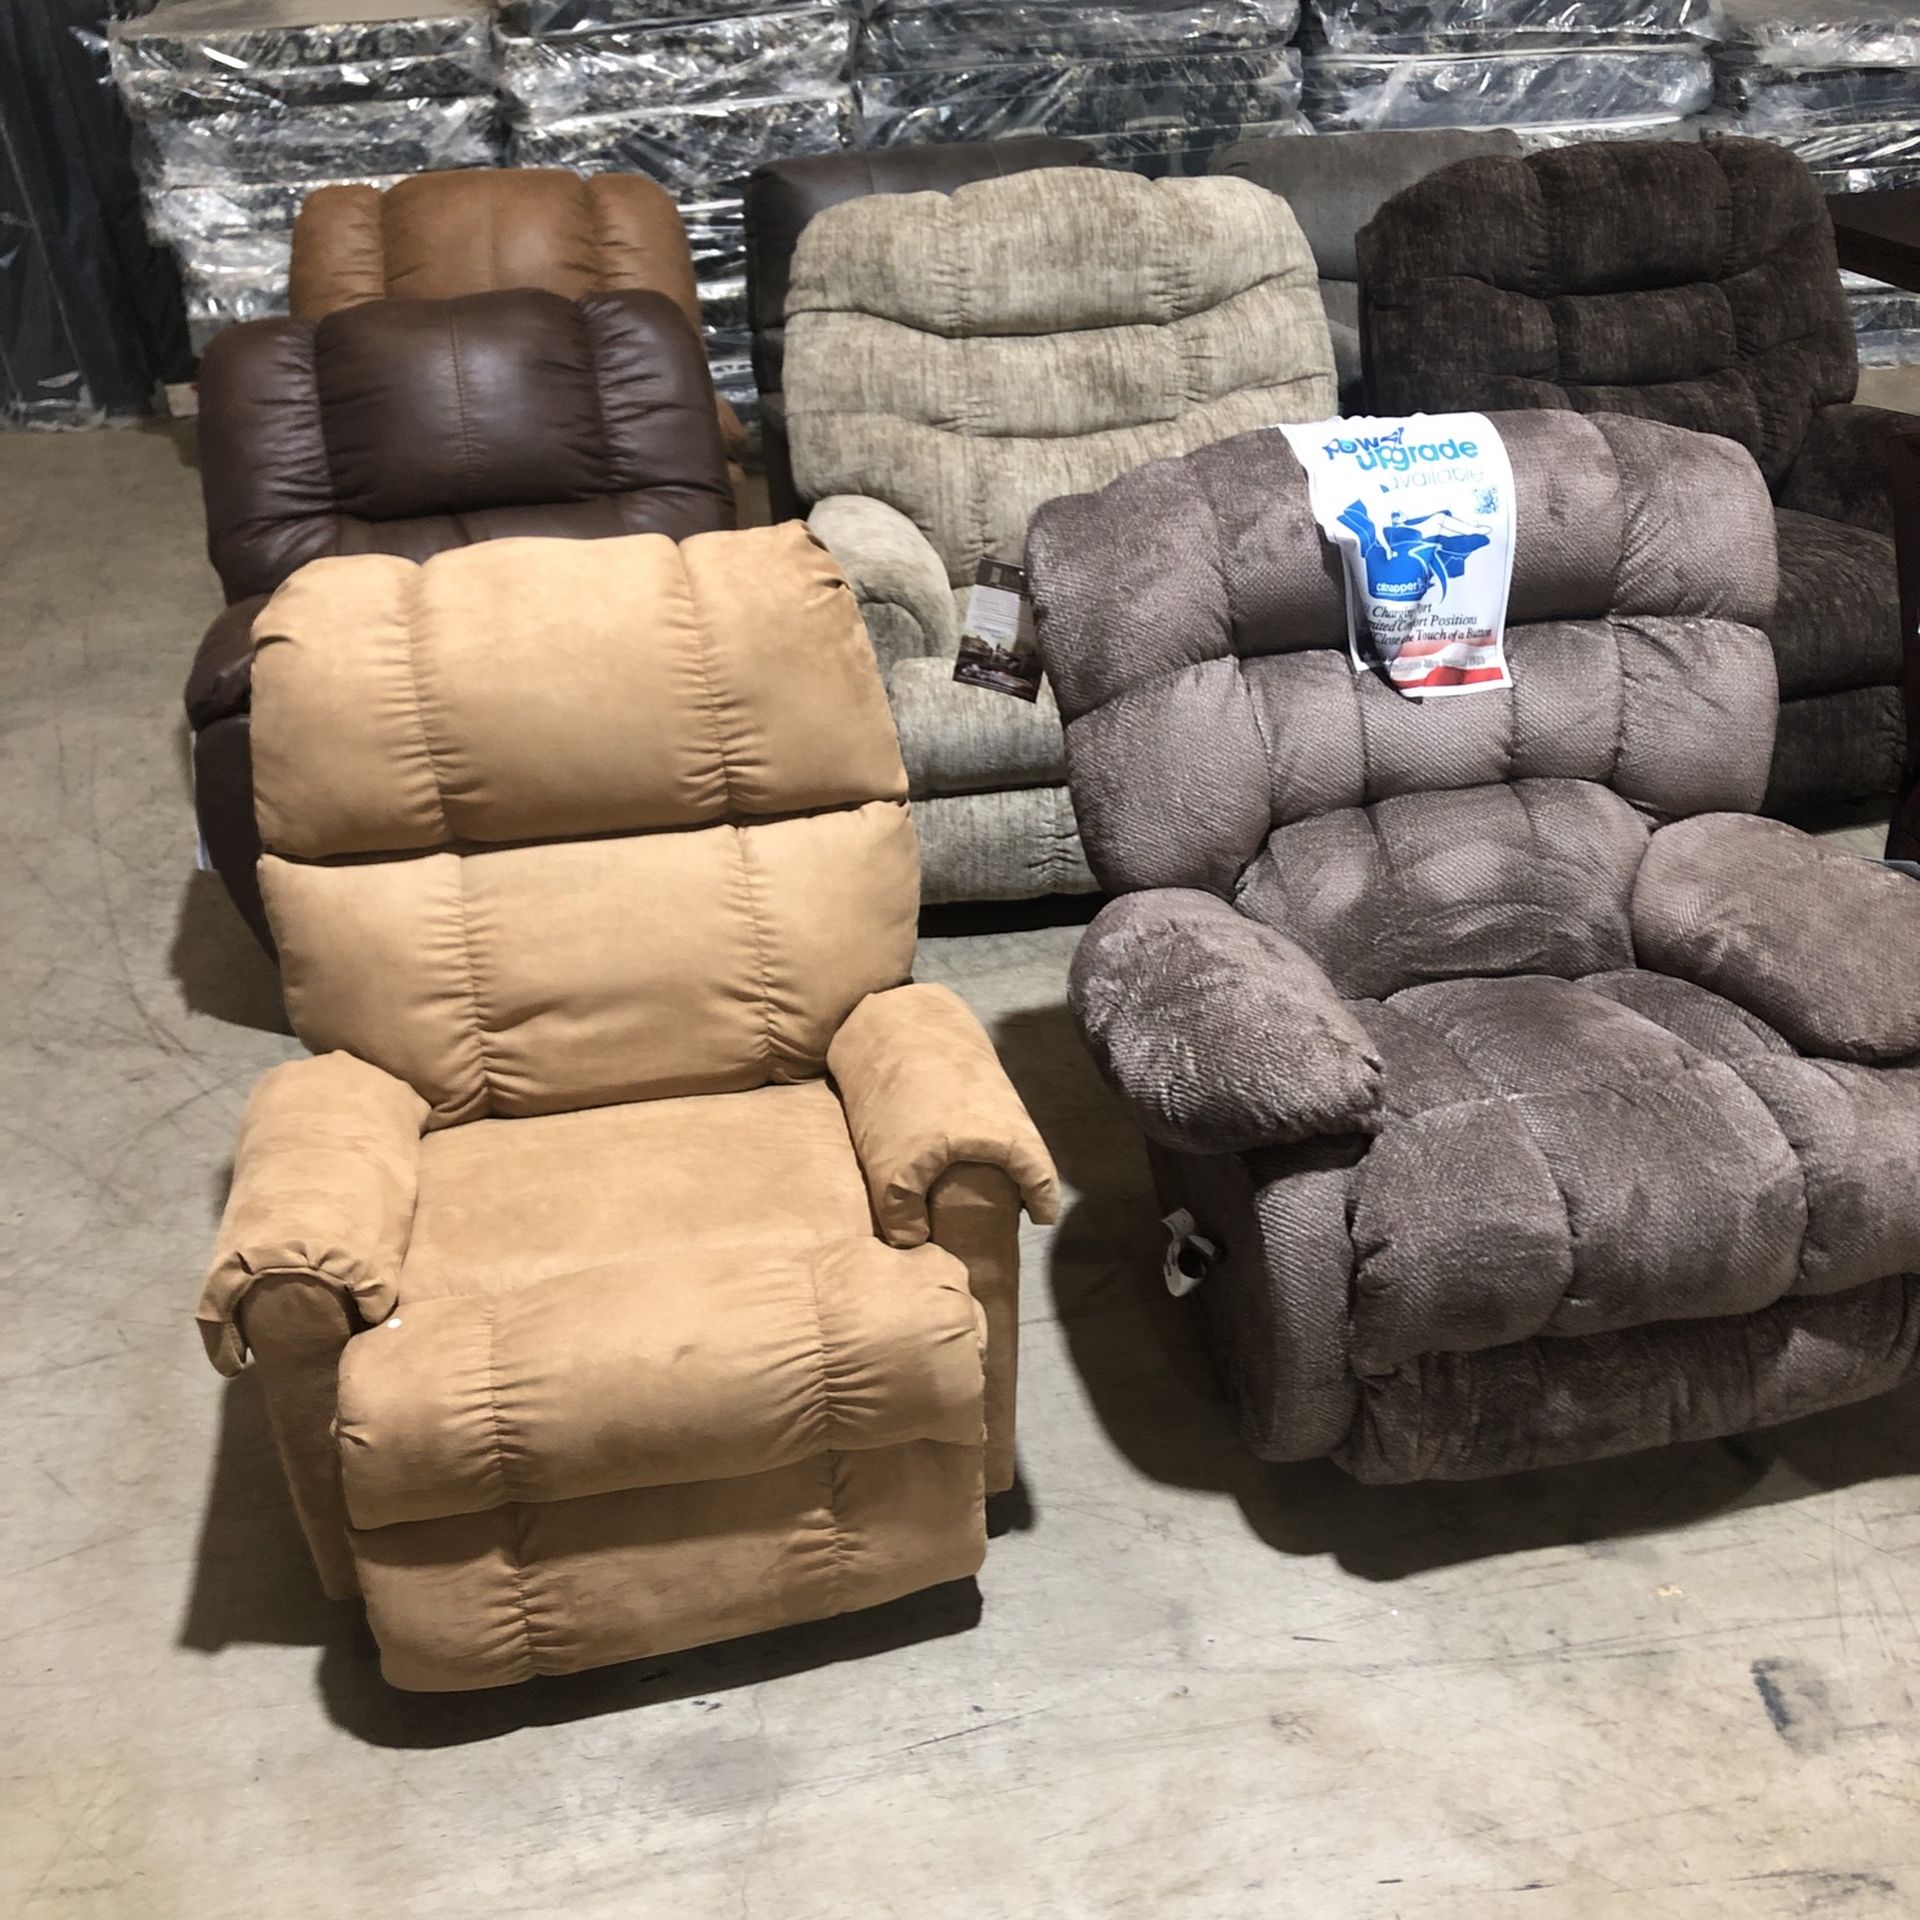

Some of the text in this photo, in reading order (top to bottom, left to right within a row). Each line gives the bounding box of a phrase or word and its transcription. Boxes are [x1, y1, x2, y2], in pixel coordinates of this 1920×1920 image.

[1355, 439, 1478, 471] upgrade
[1416, 628, 1446, 640] Touch
[1448, 630, 1457, 641] of
